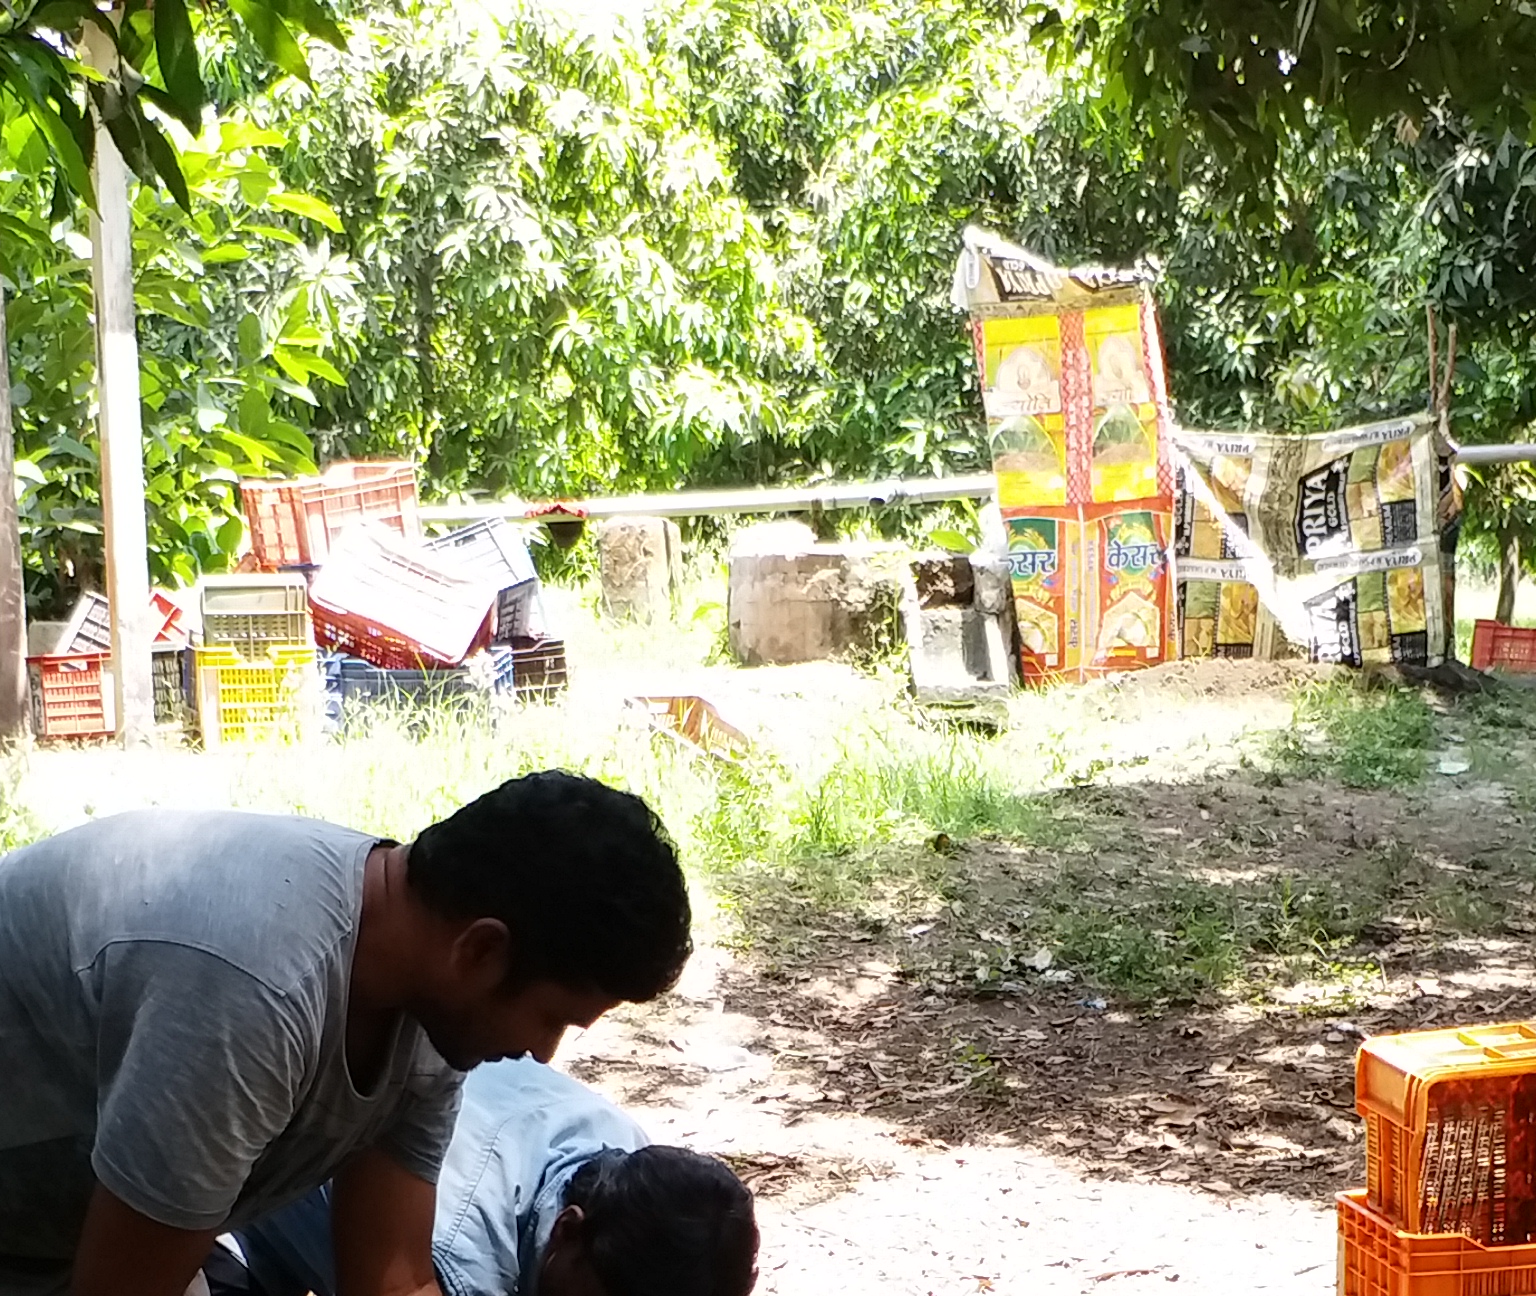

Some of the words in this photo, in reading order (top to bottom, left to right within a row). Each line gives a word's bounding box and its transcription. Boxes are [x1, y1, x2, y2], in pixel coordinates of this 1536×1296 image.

[1216, 442, 1250, 453] PRIYA
[1302, 469, 1330, 556] PRIYA
[1326, 491, 1339, 528] GOLD
[1384, 554, 1417, 567] PRIYA
